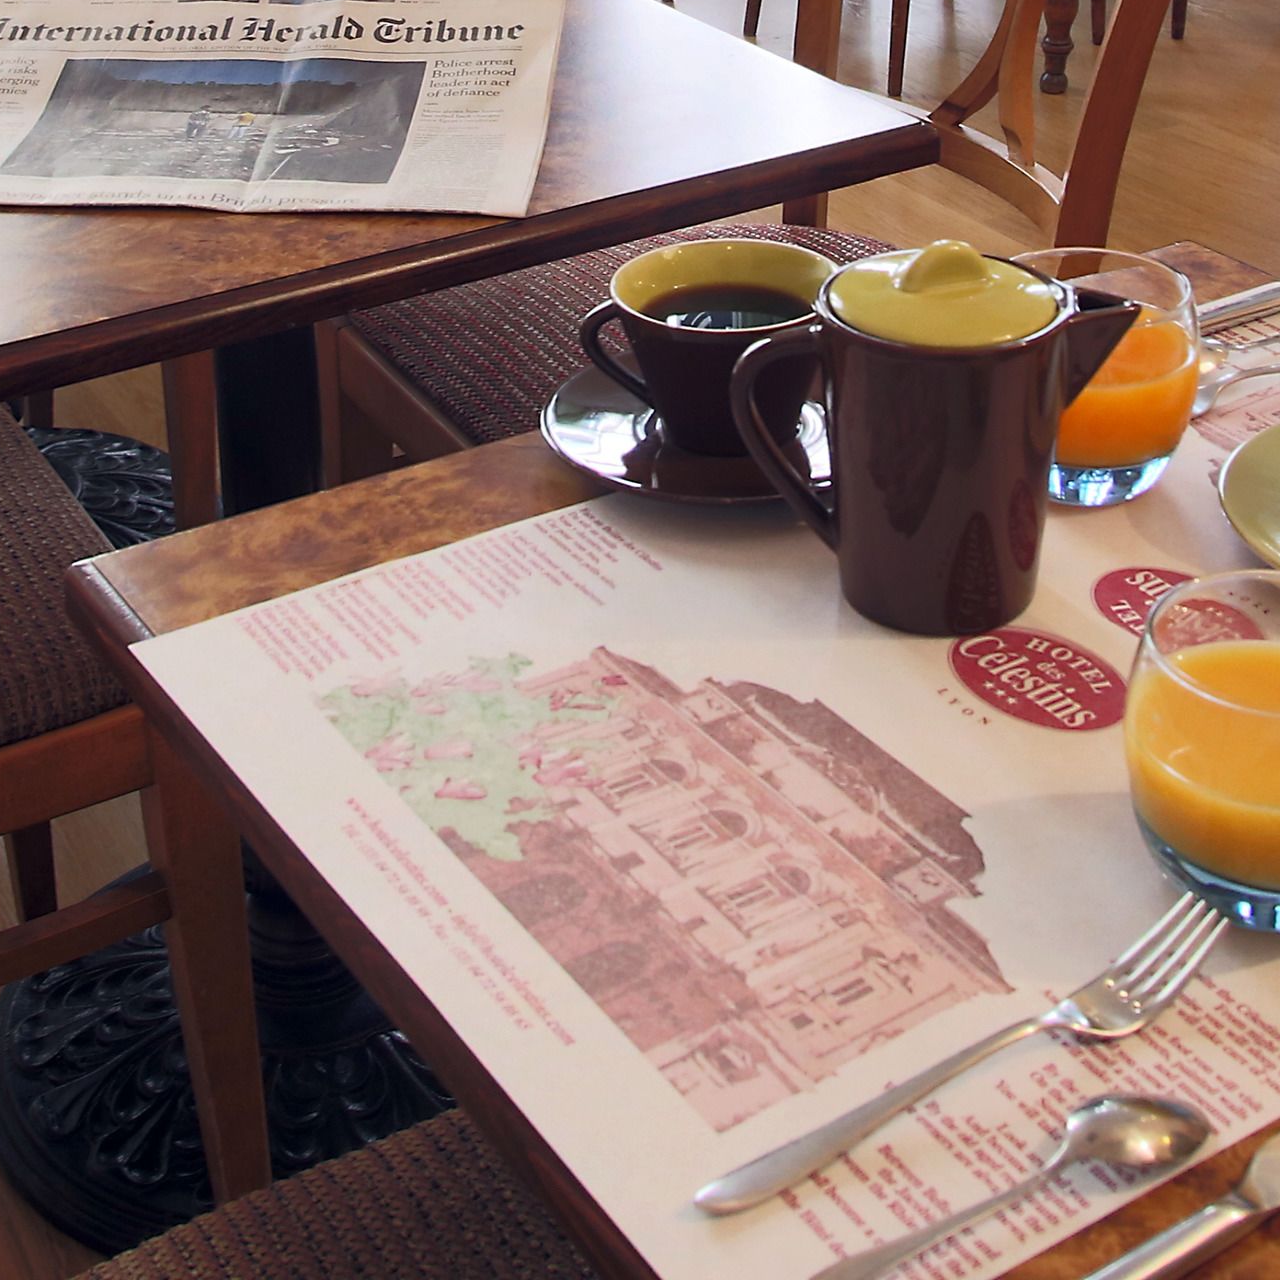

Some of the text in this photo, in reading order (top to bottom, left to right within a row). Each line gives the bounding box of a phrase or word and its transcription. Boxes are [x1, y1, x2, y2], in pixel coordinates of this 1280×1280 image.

[238, 14, 365, 43] Herald
[373, 17, 526, 44] Tribune
[0, 56, 36, 66] policy
[8, 66, 38, 74] risks
[432, 67, 517, 78] Brotherhood
[434, 59, 473, 68] Police
[426, 88, 501, 98] of defiance
[429, 77, 510, 88] leader in act
[1024, 636, 1113, 694] HOTEL
[1035, 661, 1067, 680] des
[958, 635, 1097, 729] Célestins
[937, 686, 993, 727] LYON
[1216, 989, 1236, 1002] the
[1176, 1007, 1200, 1024] will
[1197, 1025, 1223, 1044] take
[1223, 1046, 1247, 1064] care
[1203, 1014, 1224, 1029] you
[1225, 1029, 1248, 1045] will
[1214, 1003, 1249, 1028] From
[1245, 1028, 1279, 1053] night
[1060, 1077, 1079, 1093] the
[1168, 1036, 1193, 1056] foot
[1191, 1056, 1213, 1073] you
[1216, 1072, 1238, 1090] will
[1237, 1091, 1264, 1113] visit
[878, 1144, 924, 1190] Between
